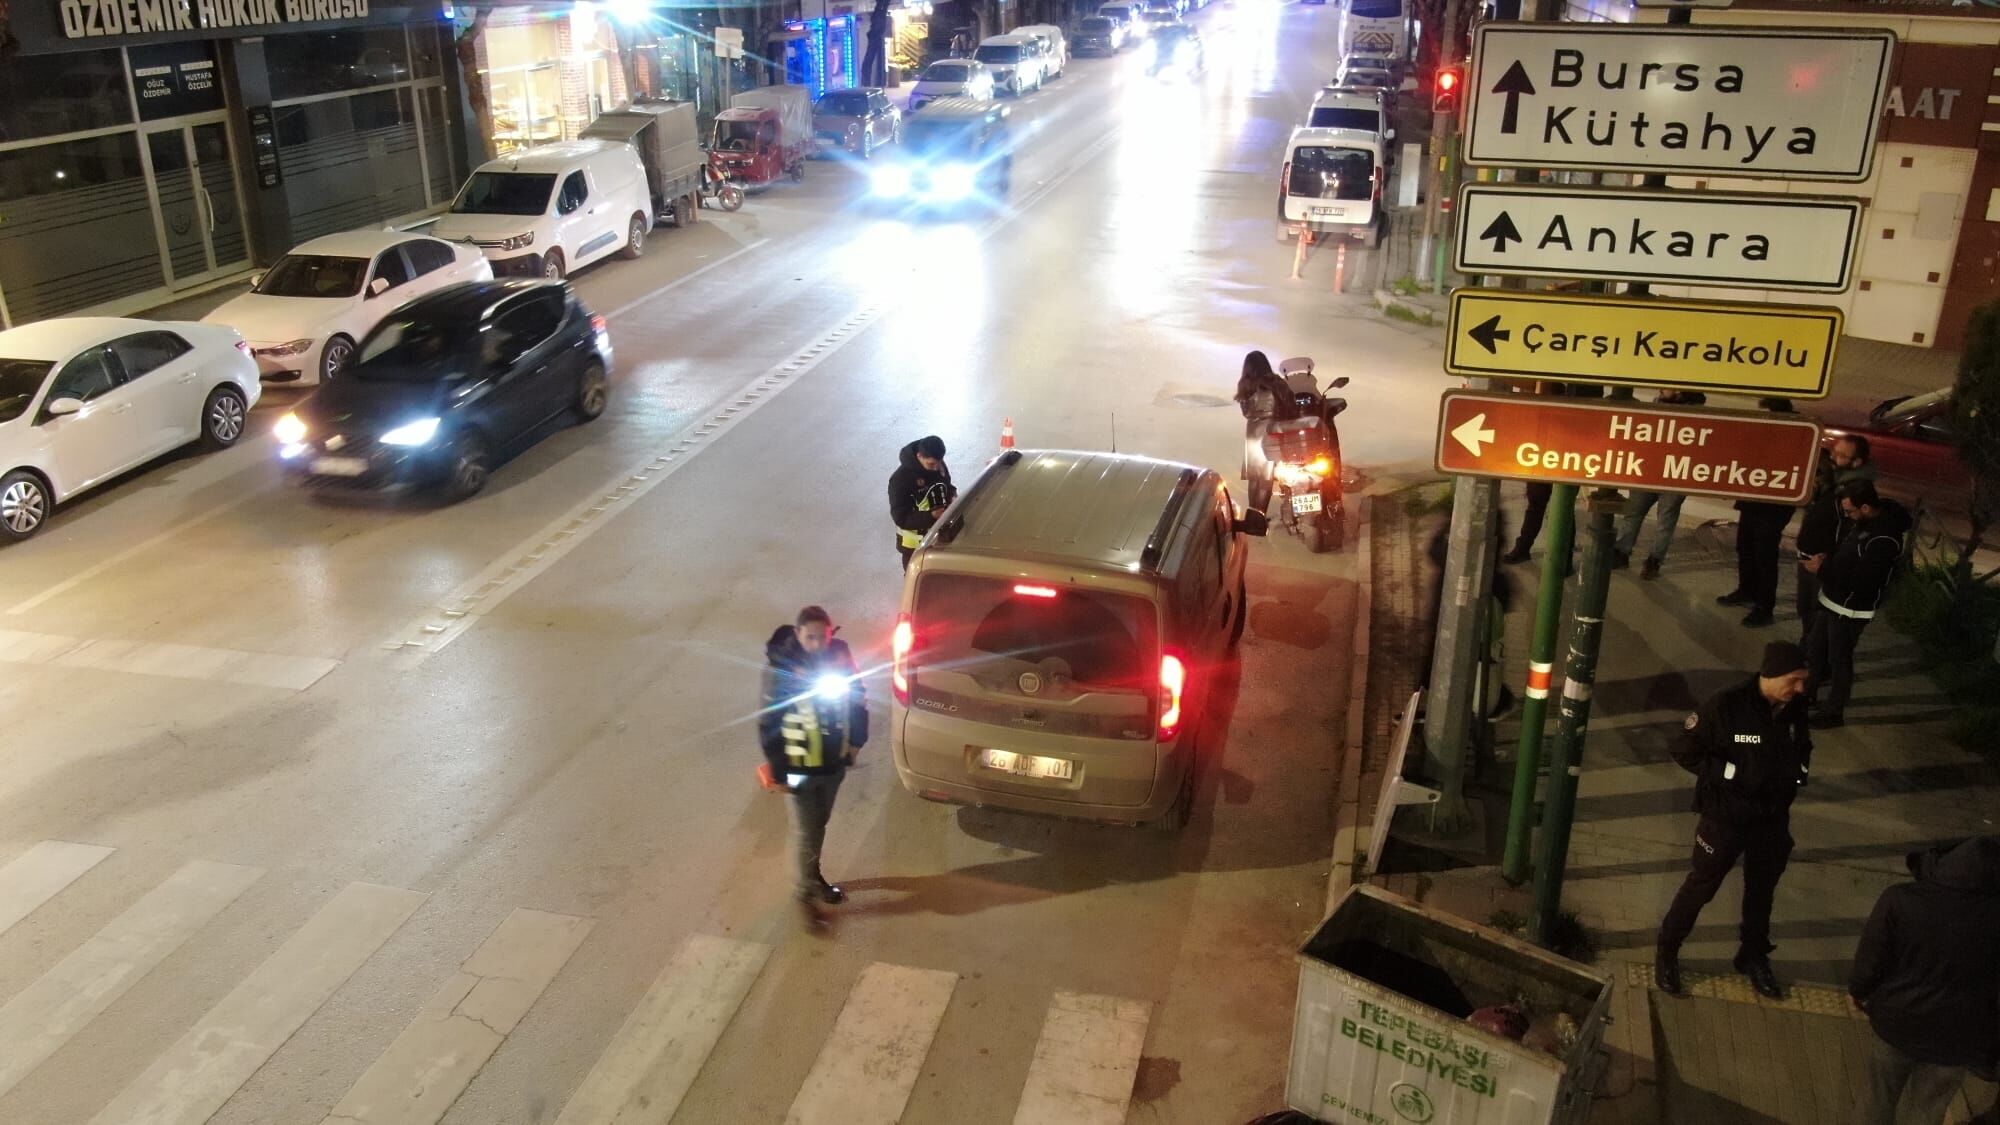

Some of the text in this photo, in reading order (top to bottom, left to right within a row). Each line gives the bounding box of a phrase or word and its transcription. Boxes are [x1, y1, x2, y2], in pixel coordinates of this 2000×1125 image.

[185, 72, 213, 81] MUSTAFA
[1550, 48, 1745, 93] Bursa
[1543, 106, 1817, 164] Kütahya
[1537, 214, 1771, 261] Ankara
[1522, 323, 1809, 369] Çarşı Karakolu
[1609, 415, 1713, 447] Haller
[1515, 442, 1801, 491] Gençlik Merkezi
[916, 698, 959, 712] DOBLO
[1734, 734, 1761, 744] BEKÇİ
[1357, 999, 1489, 1069] TEPEBAŞI
